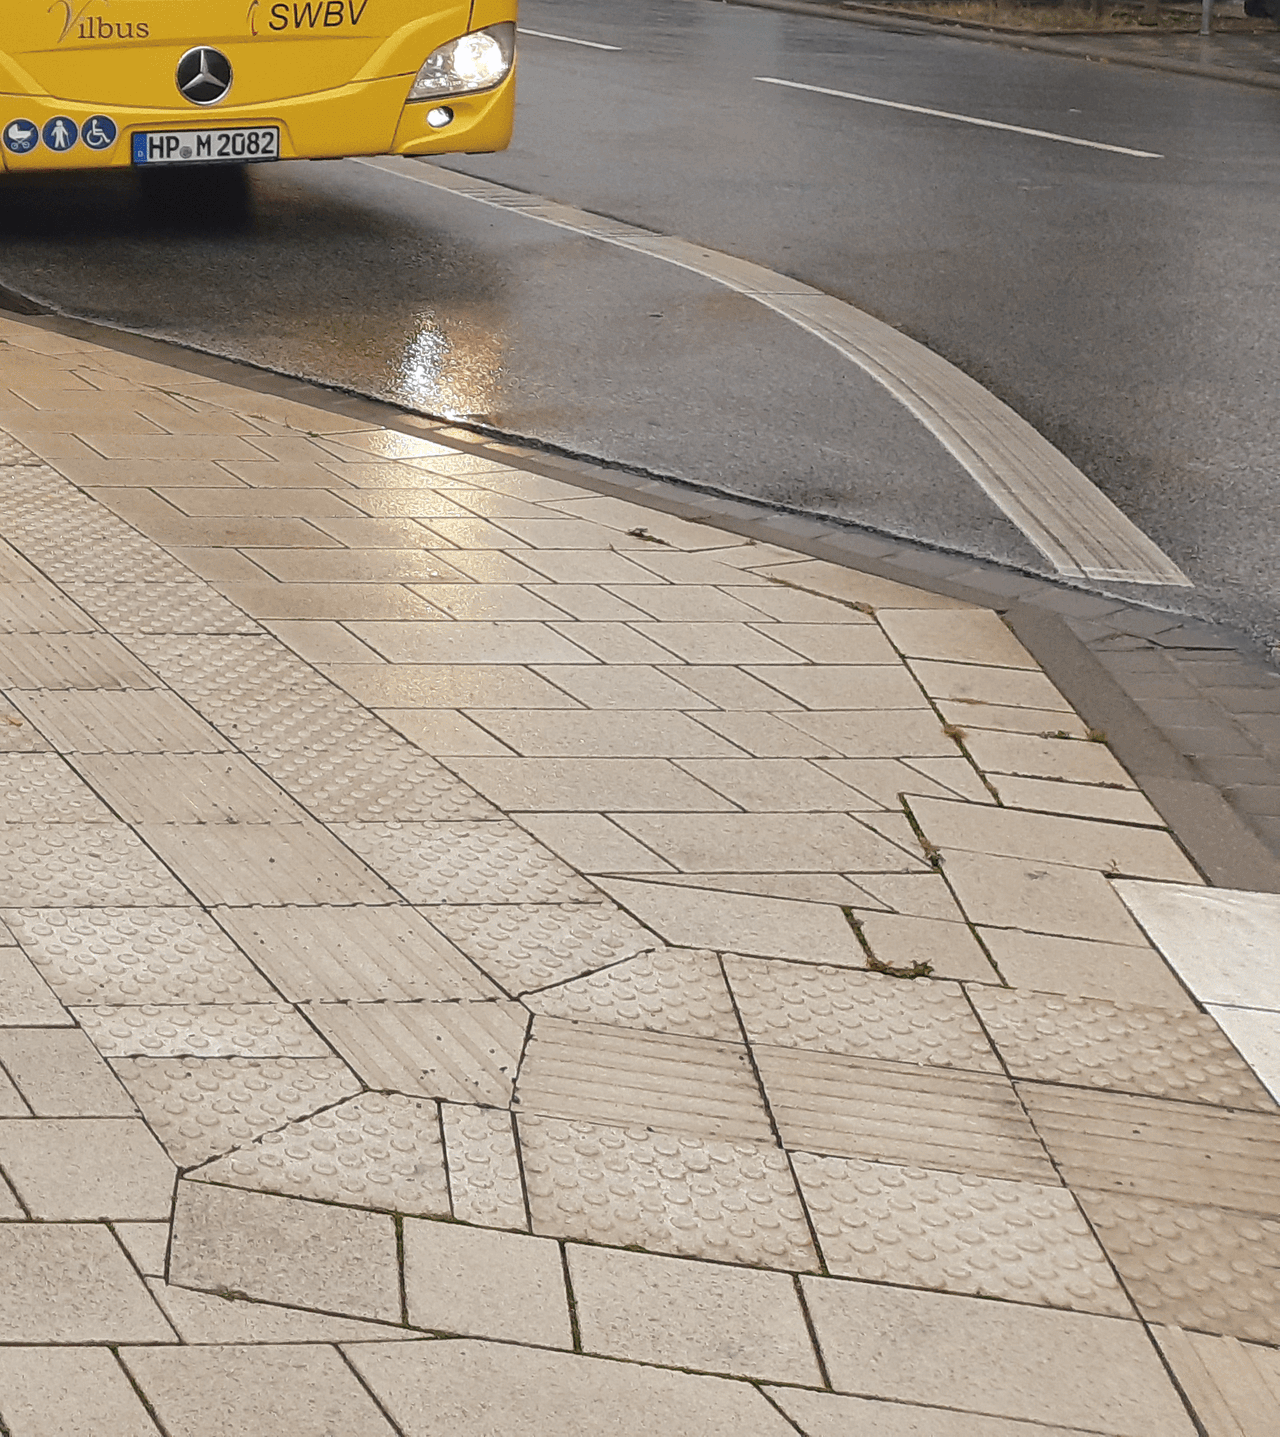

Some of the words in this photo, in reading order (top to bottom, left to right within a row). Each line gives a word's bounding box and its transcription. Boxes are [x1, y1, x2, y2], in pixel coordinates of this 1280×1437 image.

[268, 0, 368, 30] SWBV
[148, 137, 180, 159] HP
[196, 134, 212, 157] M
[217, 131, 275, 156] 2082
